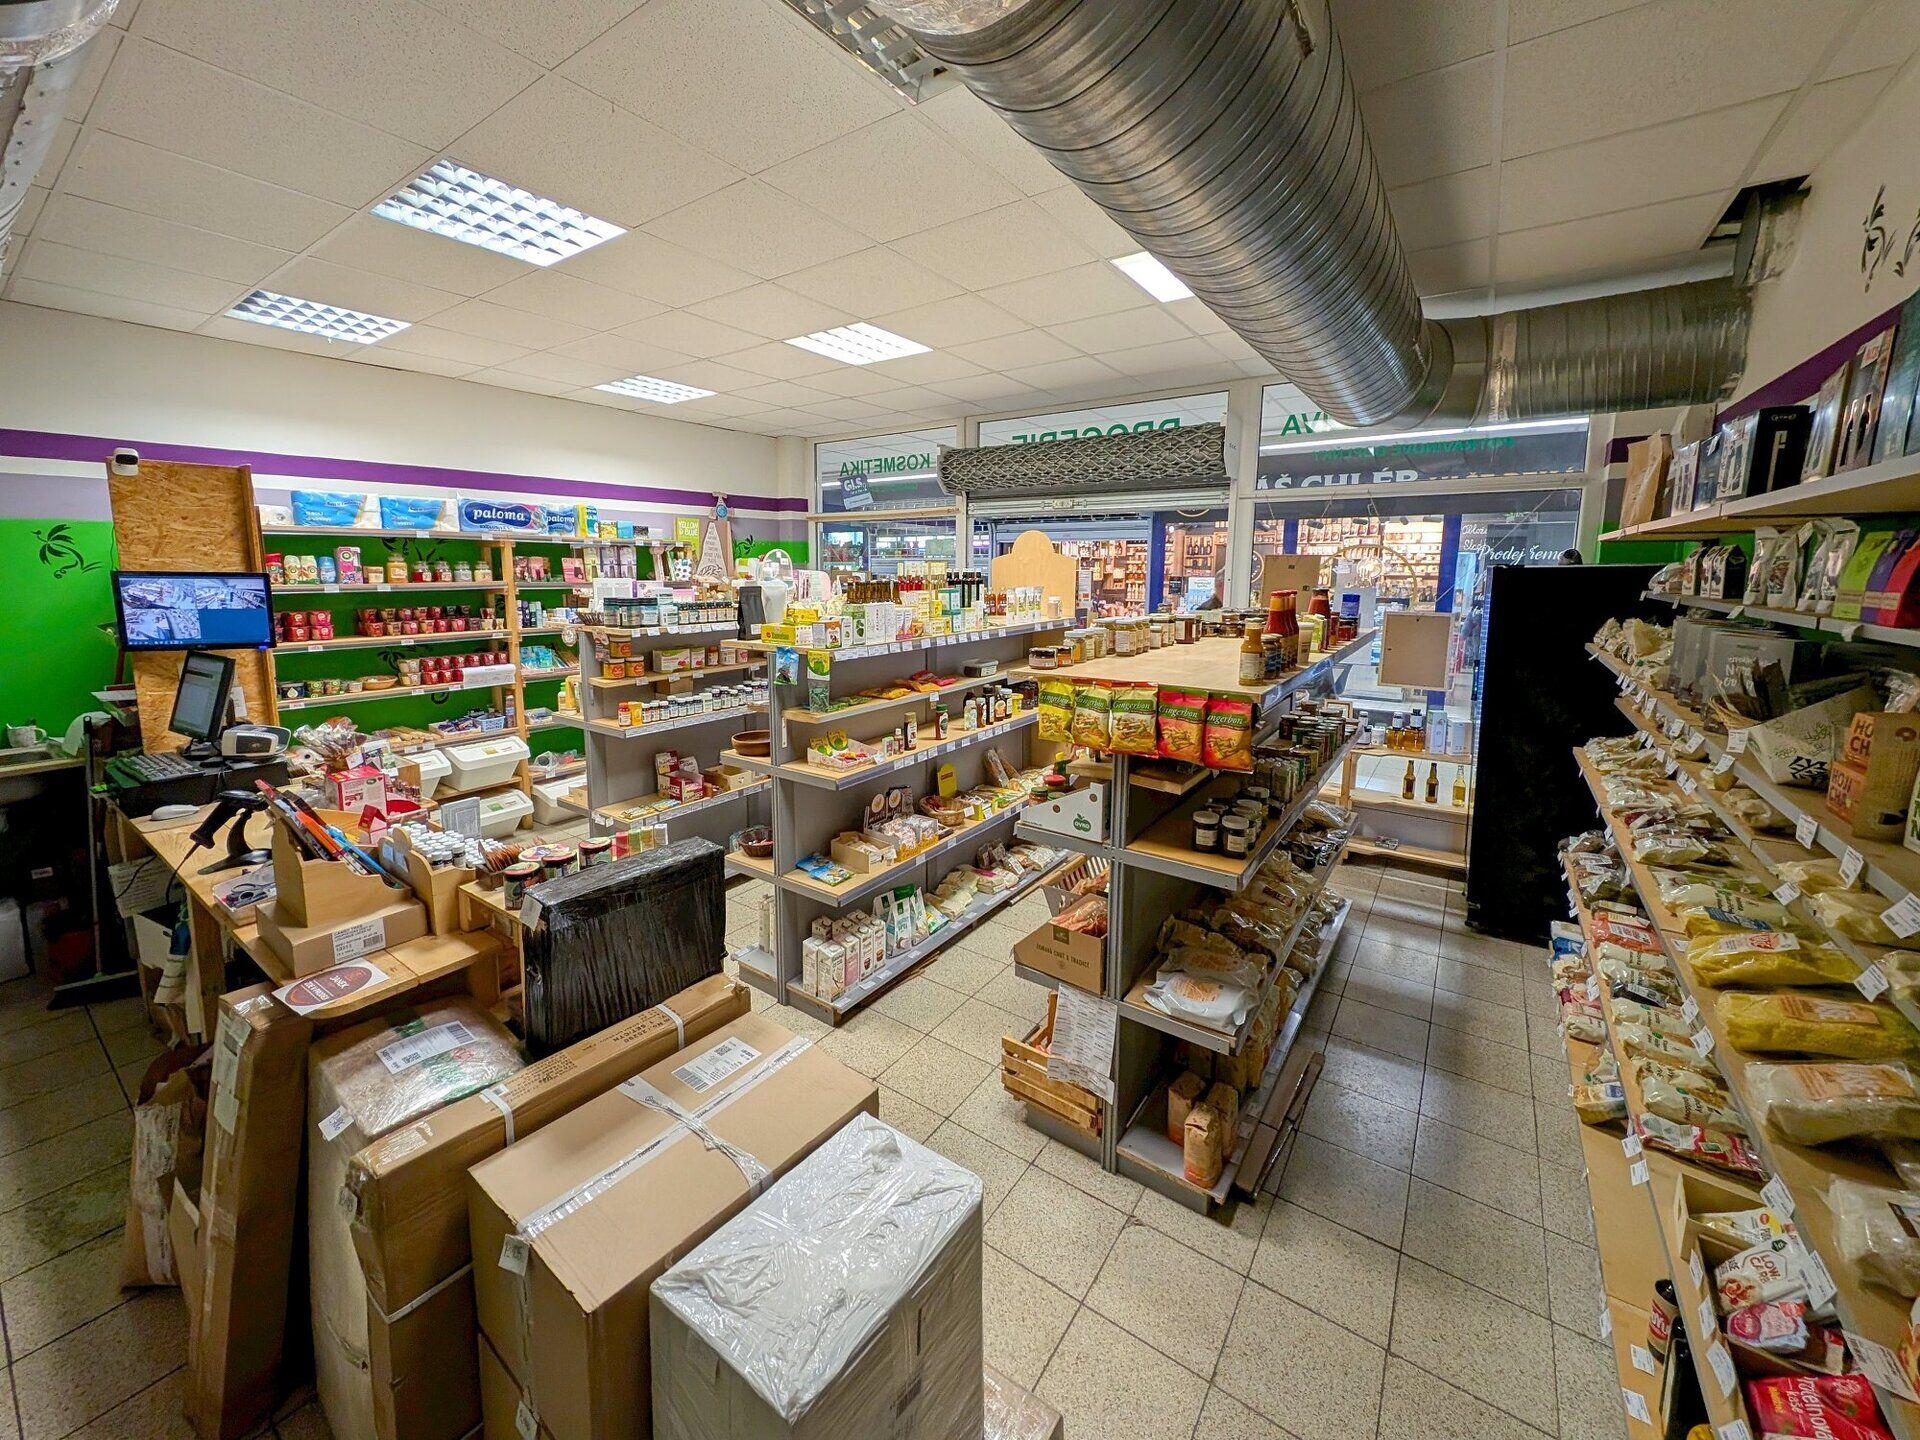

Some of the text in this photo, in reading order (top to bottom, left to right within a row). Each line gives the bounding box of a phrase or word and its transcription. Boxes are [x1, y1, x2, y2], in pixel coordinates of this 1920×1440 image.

[473, 507, 526, 521] paloma
[1478, 544, 1526, 565] Prodej
[1113, 701, 1150, 710] Gingerbon
[1207, 714, 1243, 725] ingerbon
[1761, 1254, 1781, 1279] LOW
